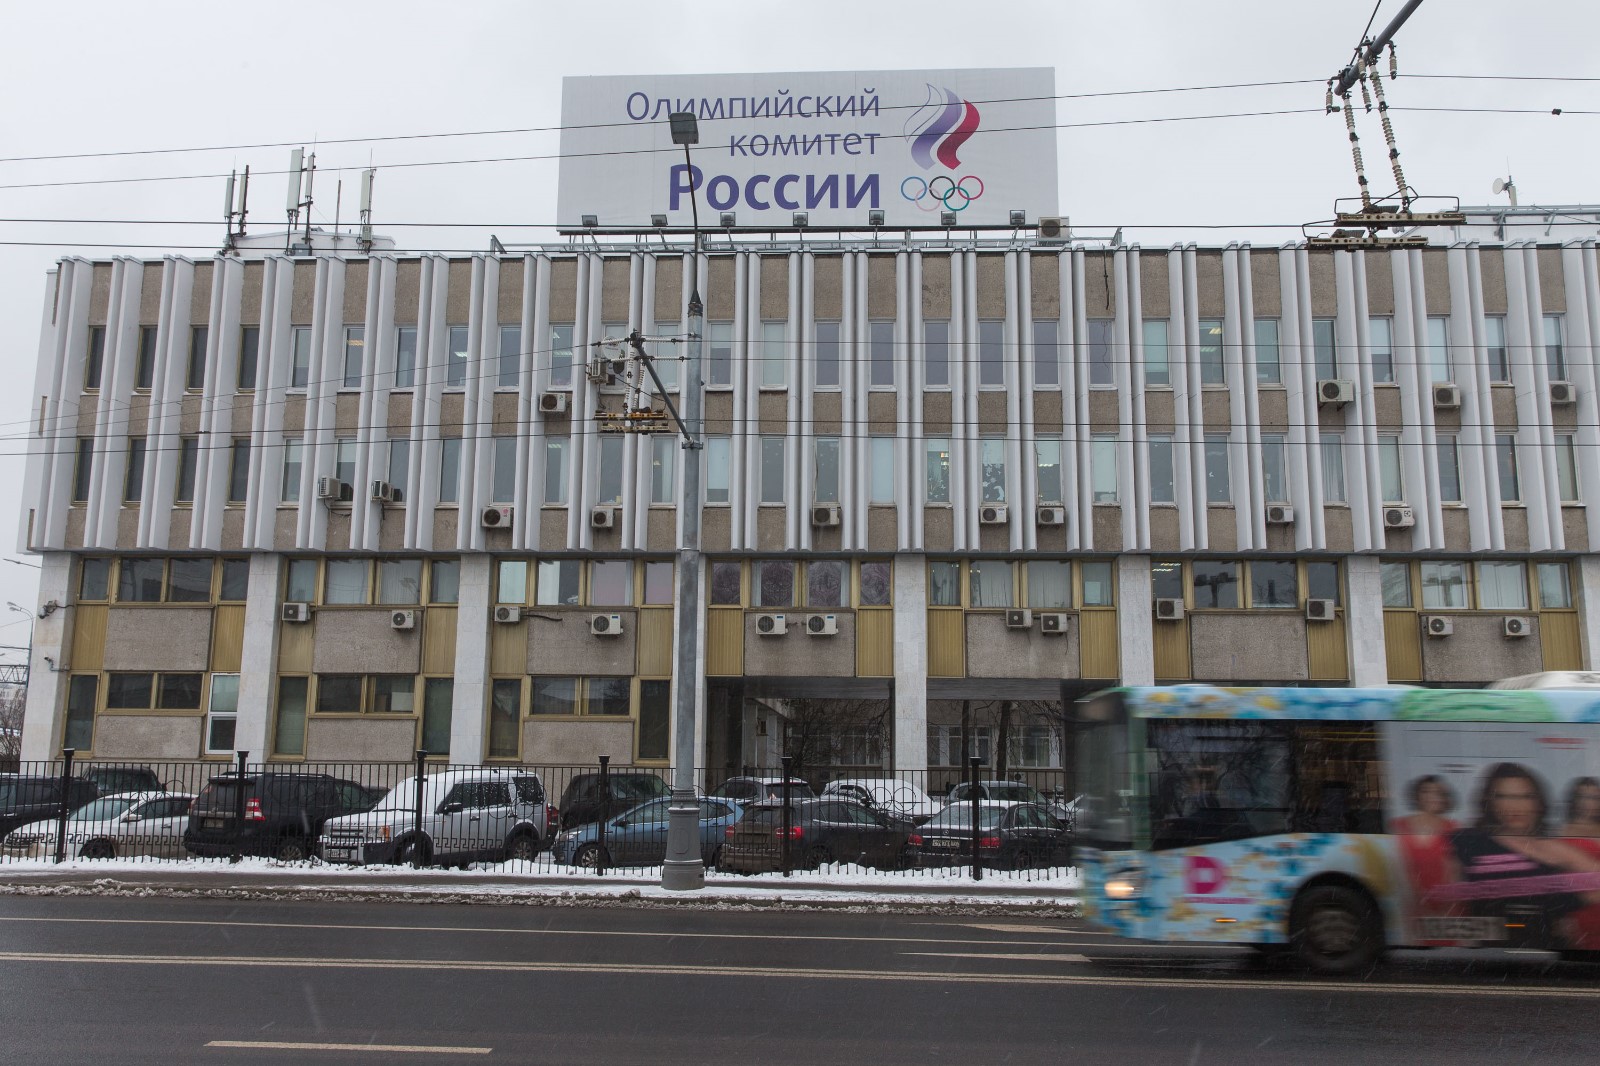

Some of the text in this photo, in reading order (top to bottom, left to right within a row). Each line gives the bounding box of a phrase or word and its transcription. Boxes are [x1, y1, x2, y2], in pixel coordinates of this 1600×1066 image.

[626, 88, 879, 120] Олимпийский
[731, 133, 881, 157] комитет
[670, 164, 880, 210] России
